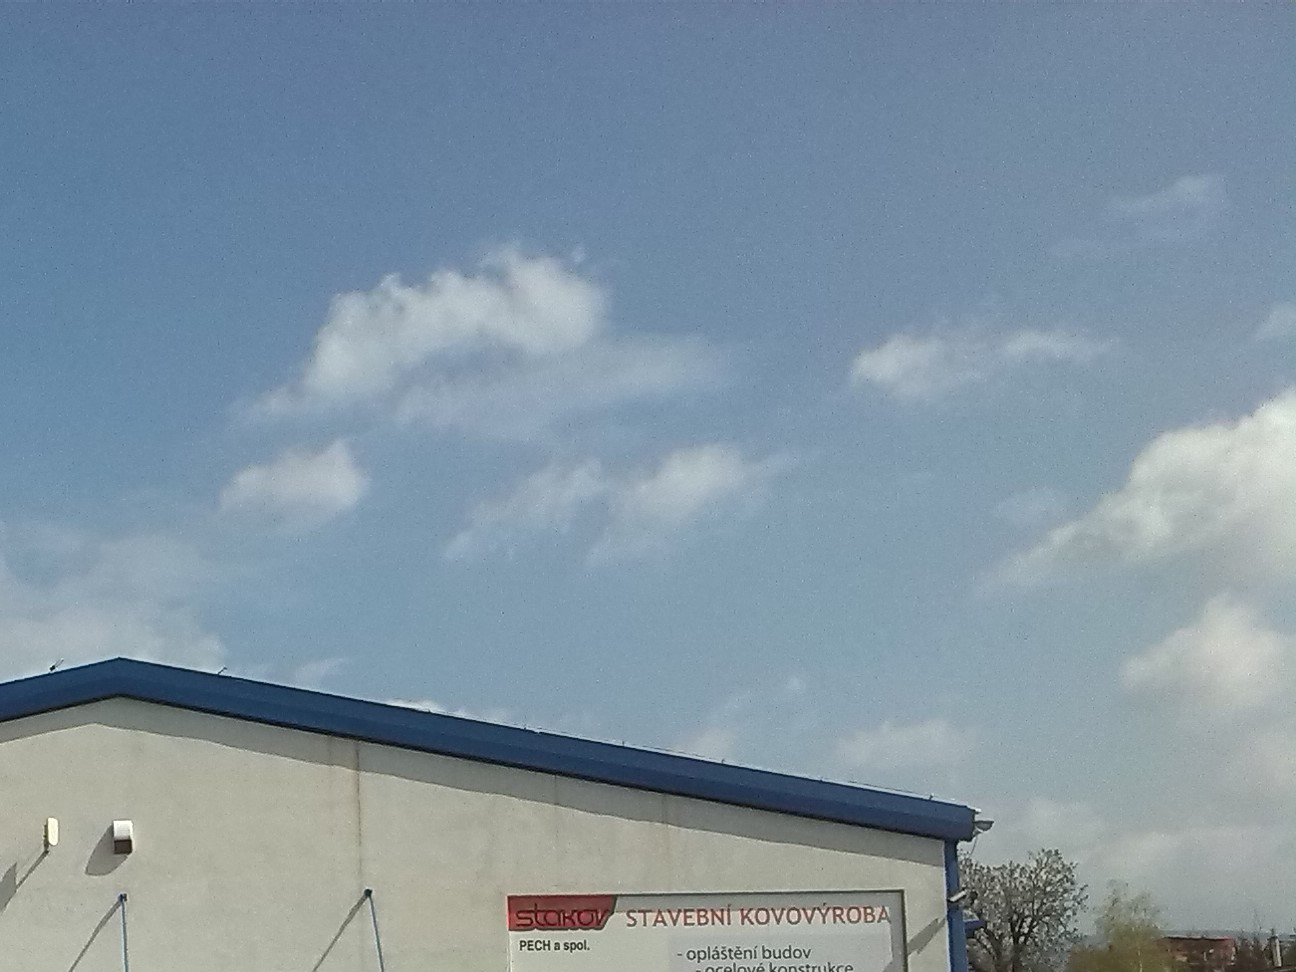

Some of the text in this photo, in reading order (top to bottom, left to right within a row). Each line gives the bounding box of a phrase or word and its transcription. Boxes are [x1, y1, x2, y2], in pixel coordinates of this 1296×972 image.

[626, 902, 892, 928] STAVEBNÍ KOVOVÝROBA
[519, 939, 590, 953] PECH a spol.
[686, 945, 812, 963] opláštění budov
